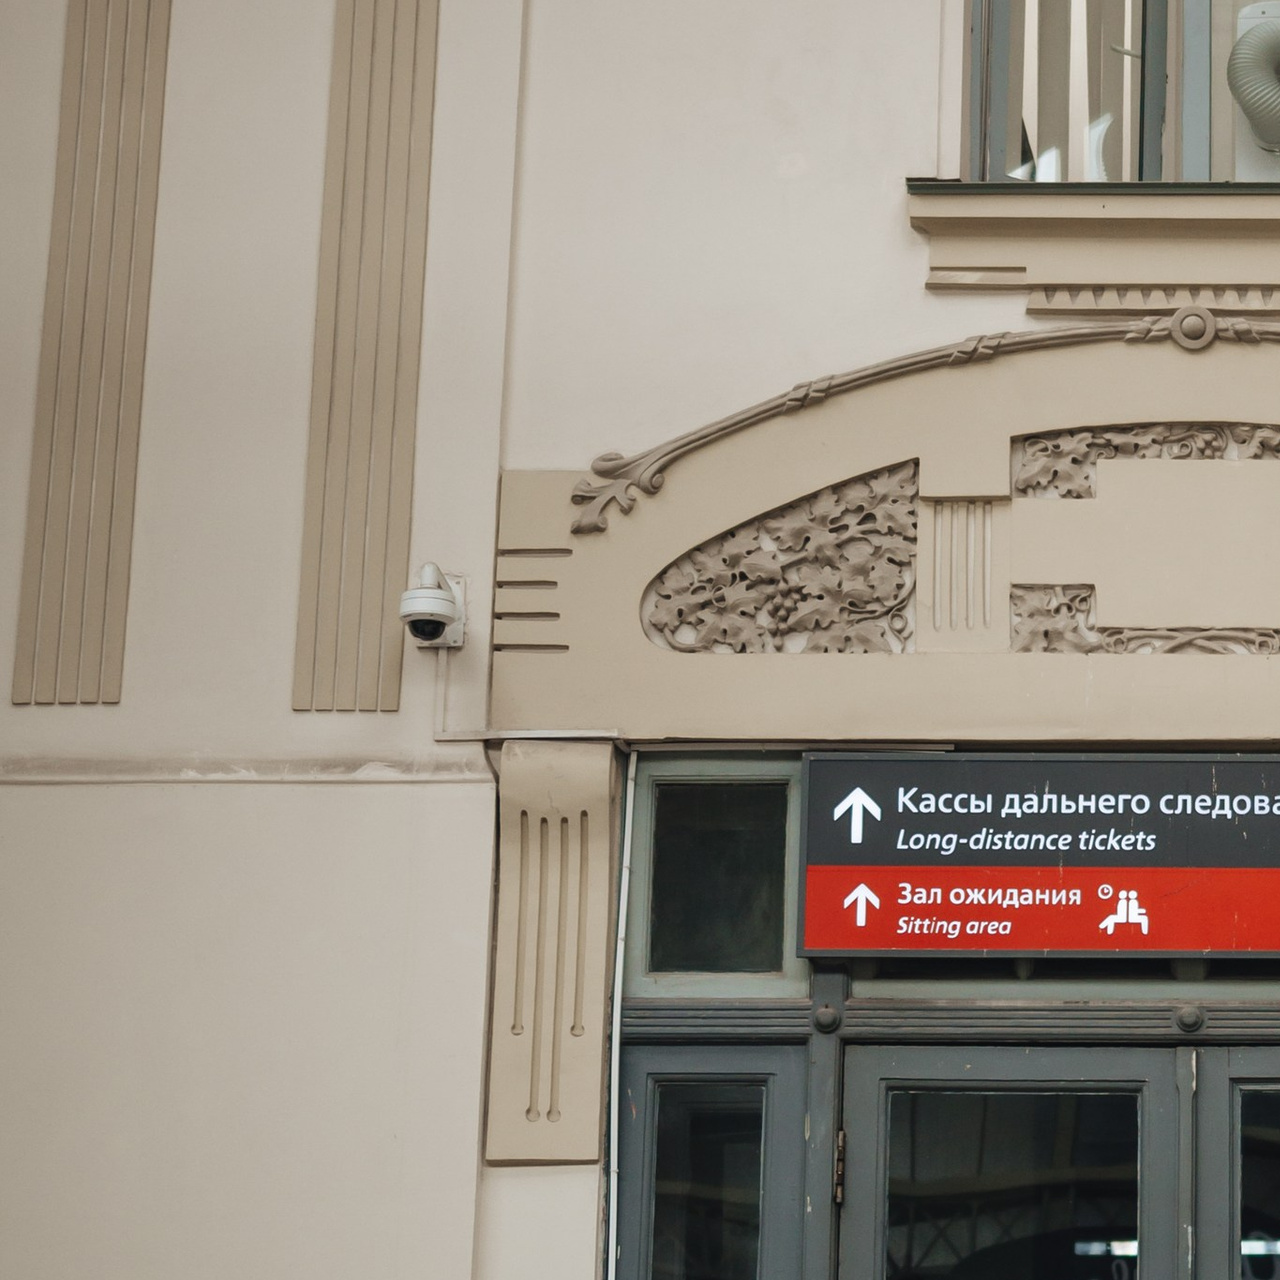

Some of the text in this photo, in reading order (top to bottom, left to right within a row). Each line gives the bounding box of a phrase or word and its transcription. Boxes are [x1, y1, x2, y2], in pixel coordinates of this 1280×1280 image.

[896, 787, 993, 814] Кассы
[1001, 790, 1151, 819] дальнего
[896, 827, 1157, 856] Long-distance tickets
[897, 882, 1081, 910] Зал ожидания
[896, 915, 1012, 939] Sitting area
